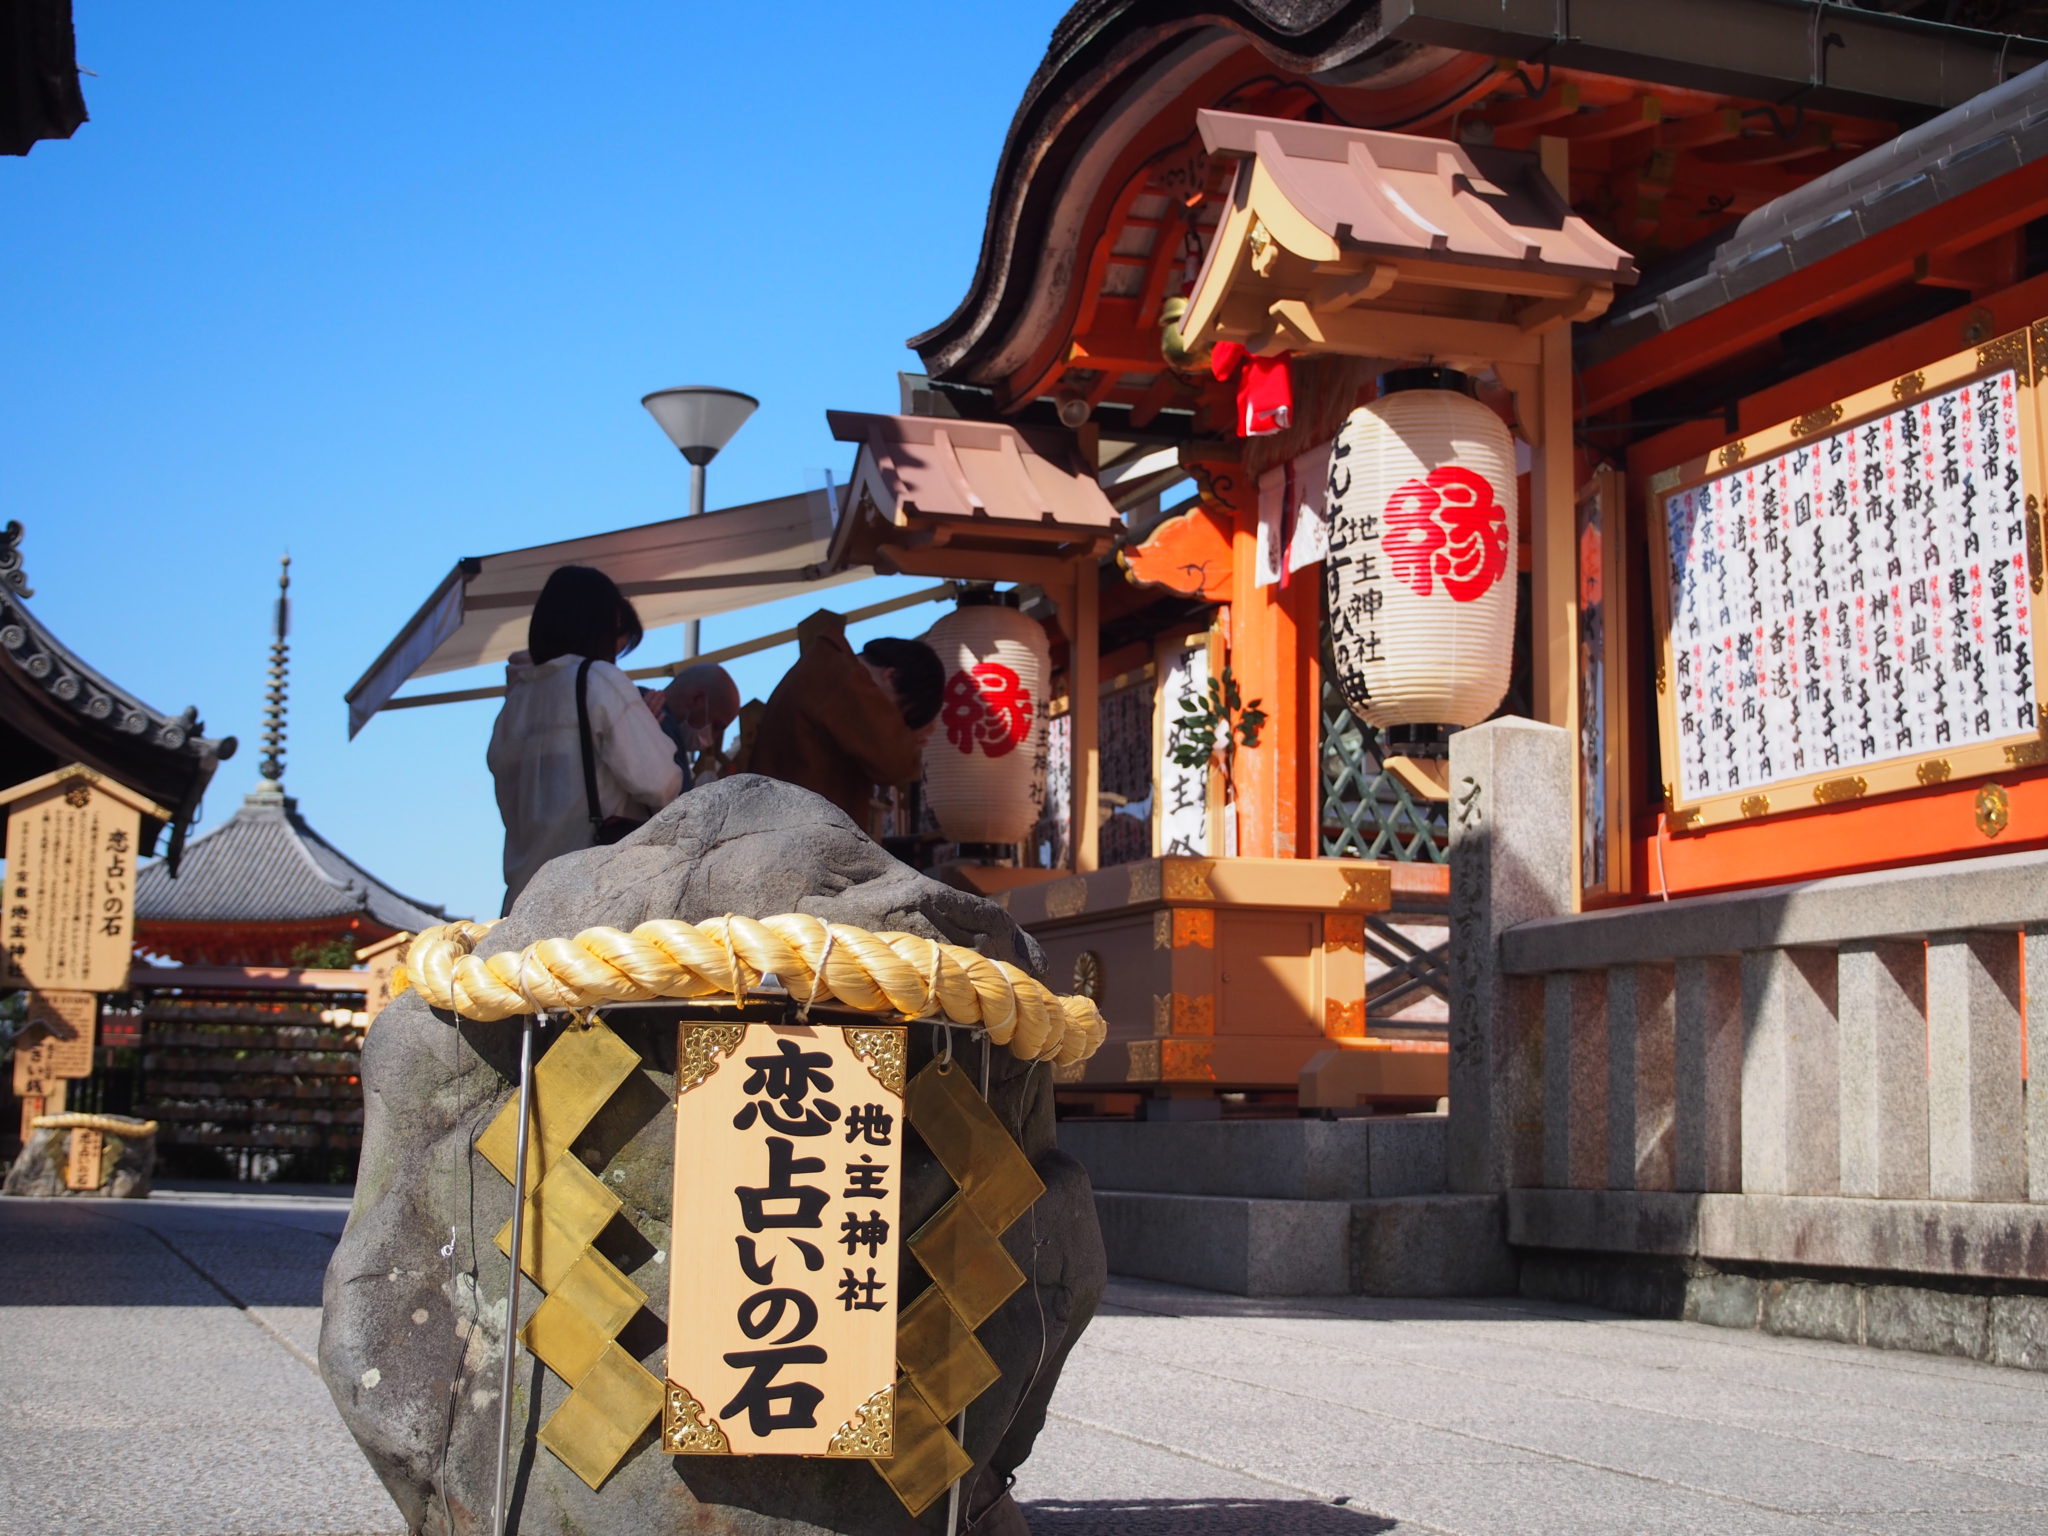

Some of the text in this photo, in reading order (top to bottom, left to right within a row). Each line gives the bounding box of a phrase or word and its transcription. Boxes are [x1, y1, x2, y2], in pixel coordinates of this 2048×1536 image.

[1828, 436, 1847, 517] 台湾
[1862, 425, 1883, 523] 京都市
[1901, 409, 1922, 511] 東京都
[1977, 379, 2000, 481] 宜野湾市
[1700, 484, 1717, 573] 東京都
[1729, 475, 1746, 552] 台湾
[1760, 464, 1779, 553] 千葉市
[1793, 450, 1812, 527] 中国
[1348, 515, 1385, 664] 地主神社
[1869, 589, 1892, 685] 神戸市
[1909, 577, 1931, 674] 岡山県
[1949, 568, 1971, 673] 東京都
[1677, 650, 1694, 737] 府中市
[1707, 644, 1723, 731] 八千代市
[1769, 620, 1791, 699] 香港
[1802, 609, 1821, 704] 奈良市
[99, 828, 130, 937] 恋占いの石
[7, 904, 29, 978] 地主神社
[720, 1038, 842, 1437] 恋占いの石
[836, 1102, 894, 1313] 地主神社
